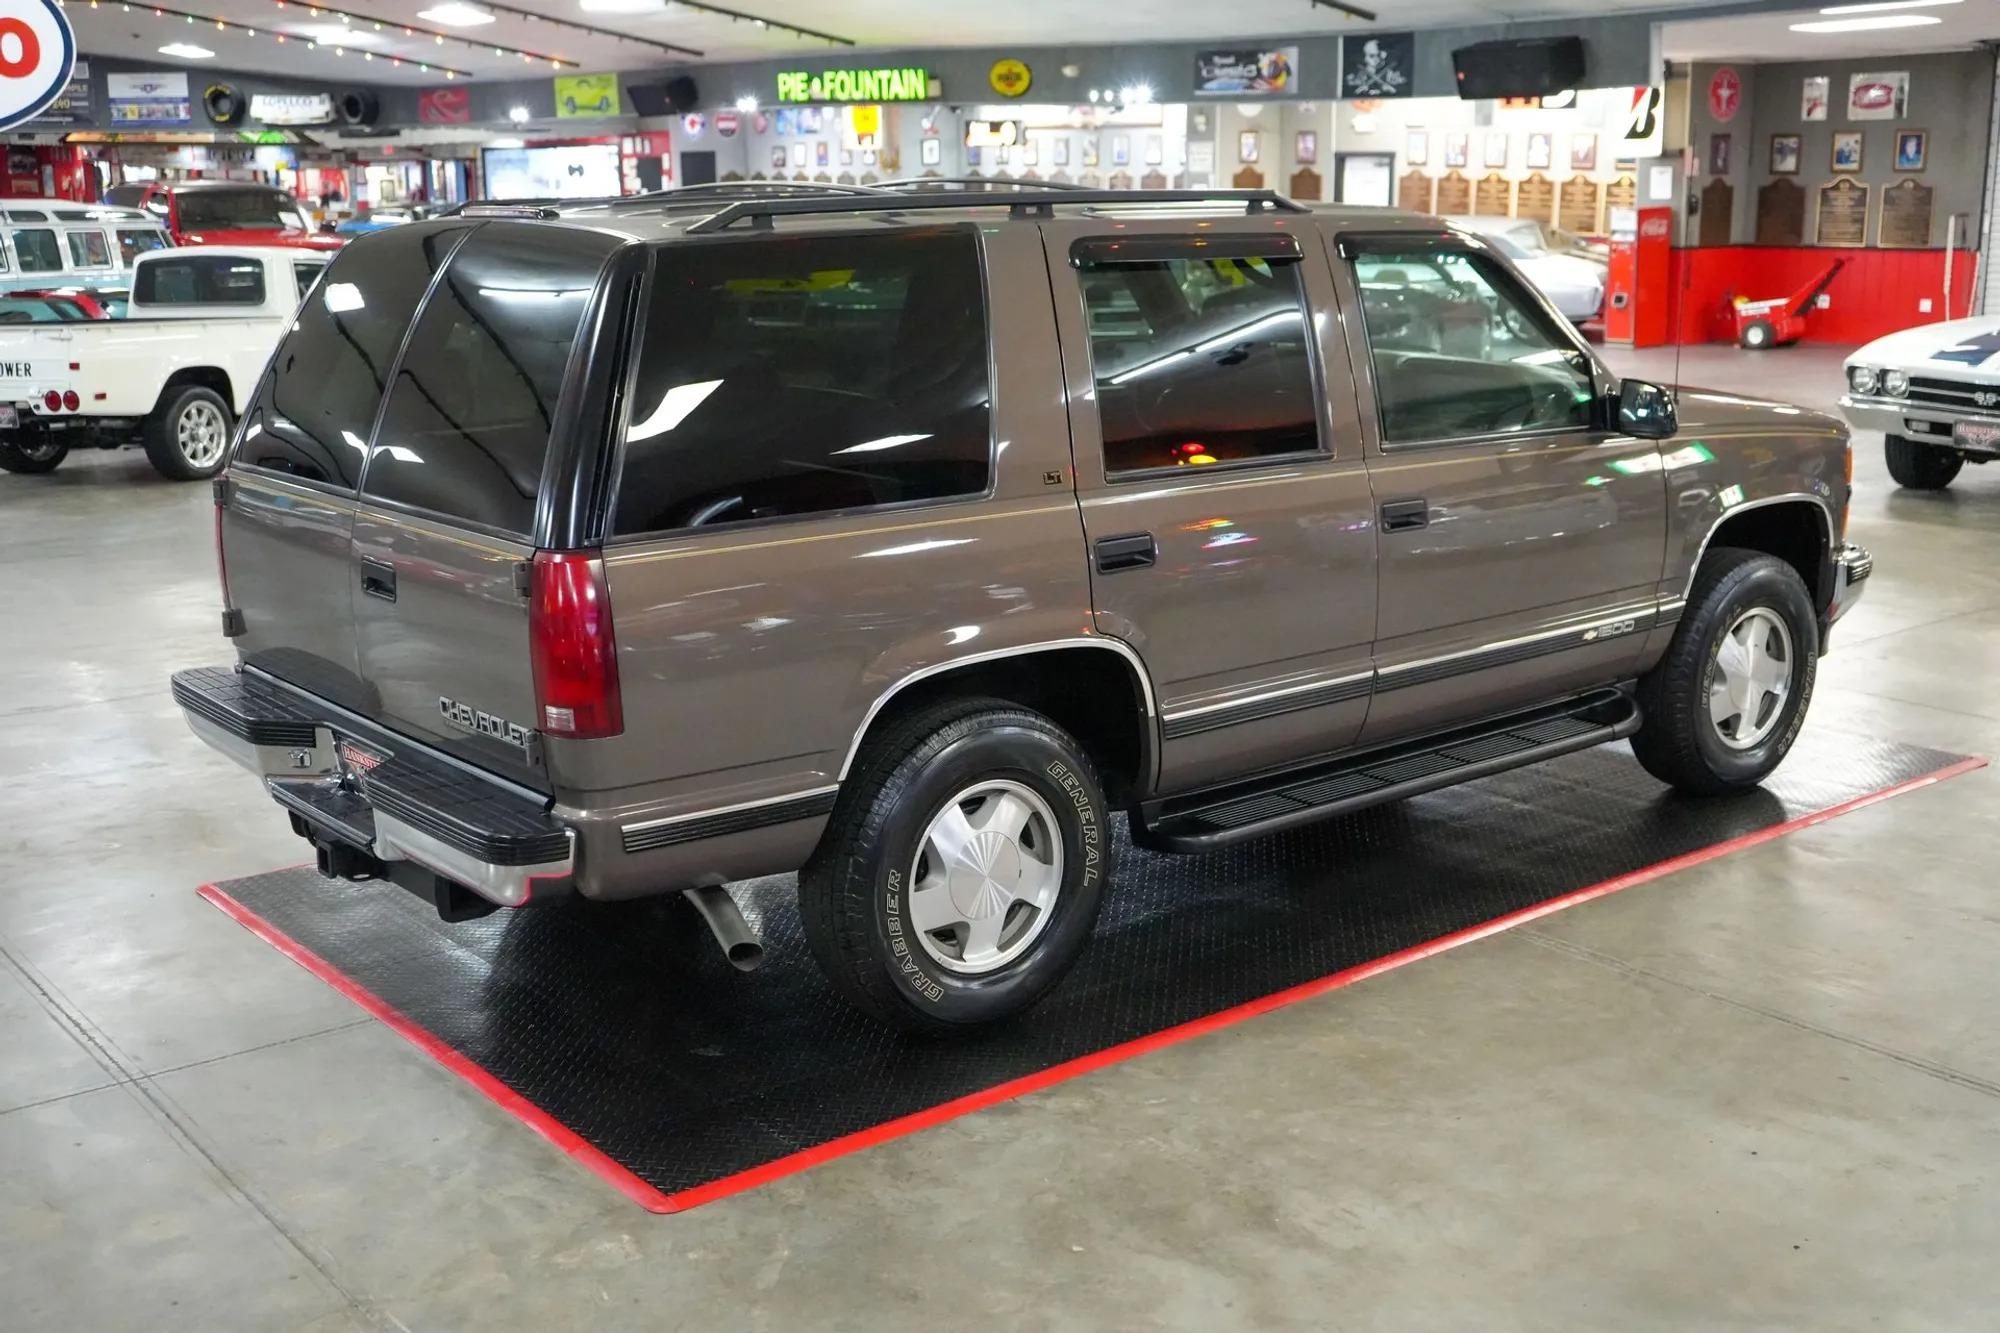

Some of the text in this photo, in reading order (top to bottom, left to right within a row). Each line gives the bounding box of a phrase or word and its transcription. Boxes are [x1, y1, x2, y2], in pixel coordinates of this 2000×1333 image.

[777, 68, 926, 101] PIE FOUNTAIN
[1043, 471, 1062, 485] LT
[439, 695, 531, 749] CHEVROLET
[1046, 759, 1100, 888] GENERAL
[886, 868, 945, 1002] GRABBER
